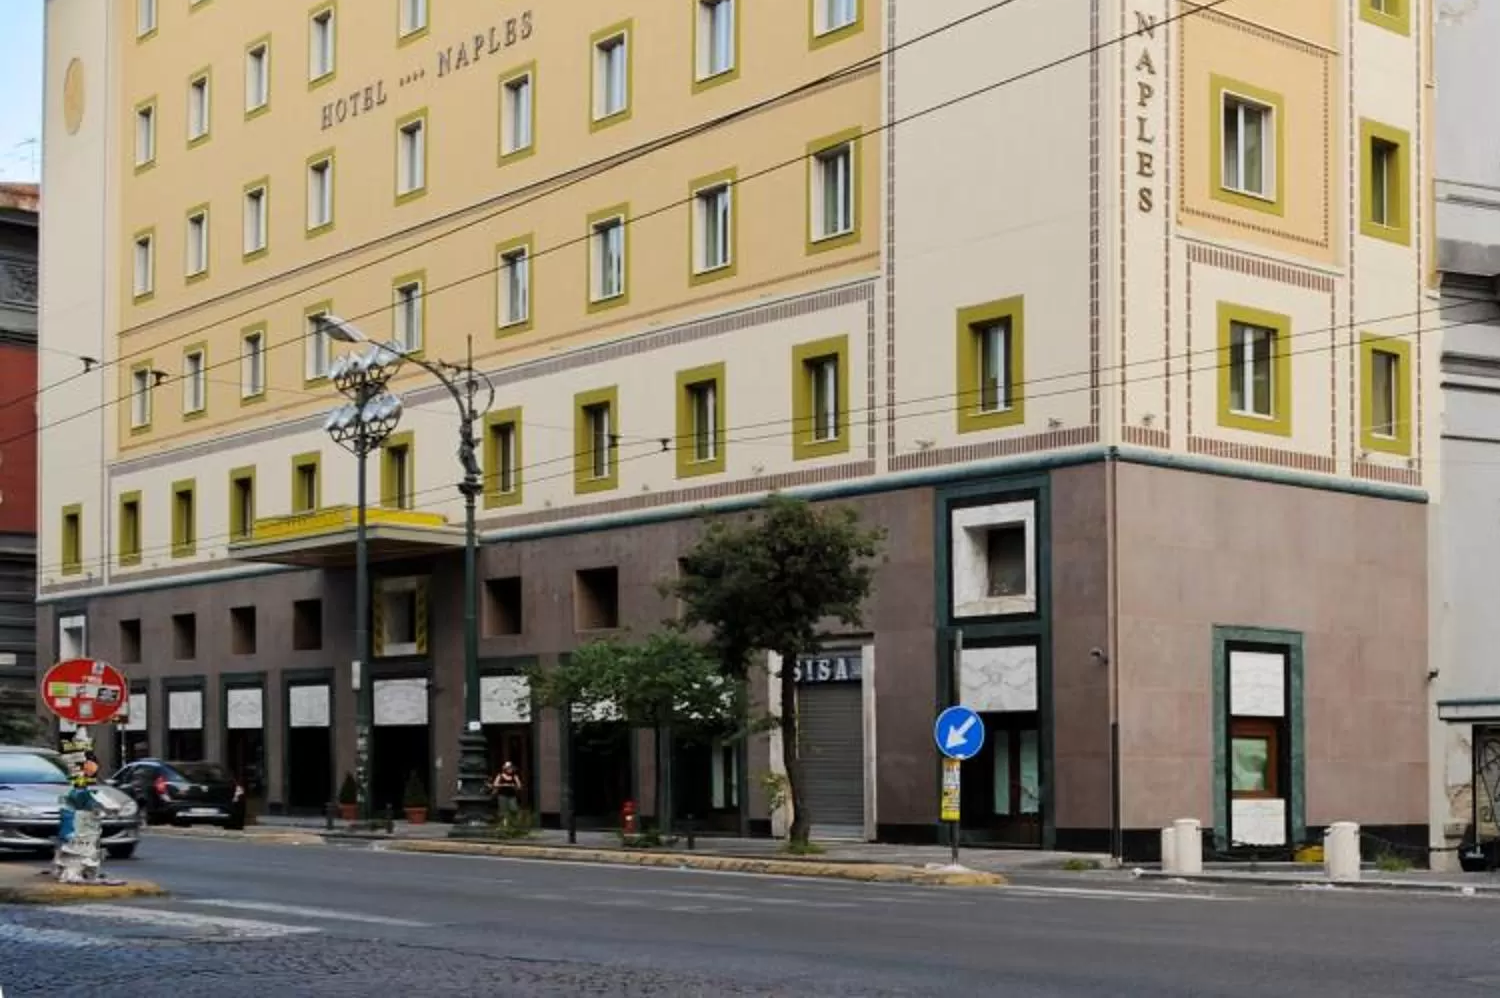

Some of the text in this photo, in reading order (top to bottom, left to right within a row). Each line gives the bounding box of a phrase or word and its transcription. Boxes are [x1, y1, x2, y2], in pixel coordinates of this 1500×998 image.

[320, 9, 534, 131] HOTEL NAPLES
[1134, 10, 1157, 213] NAPLES
